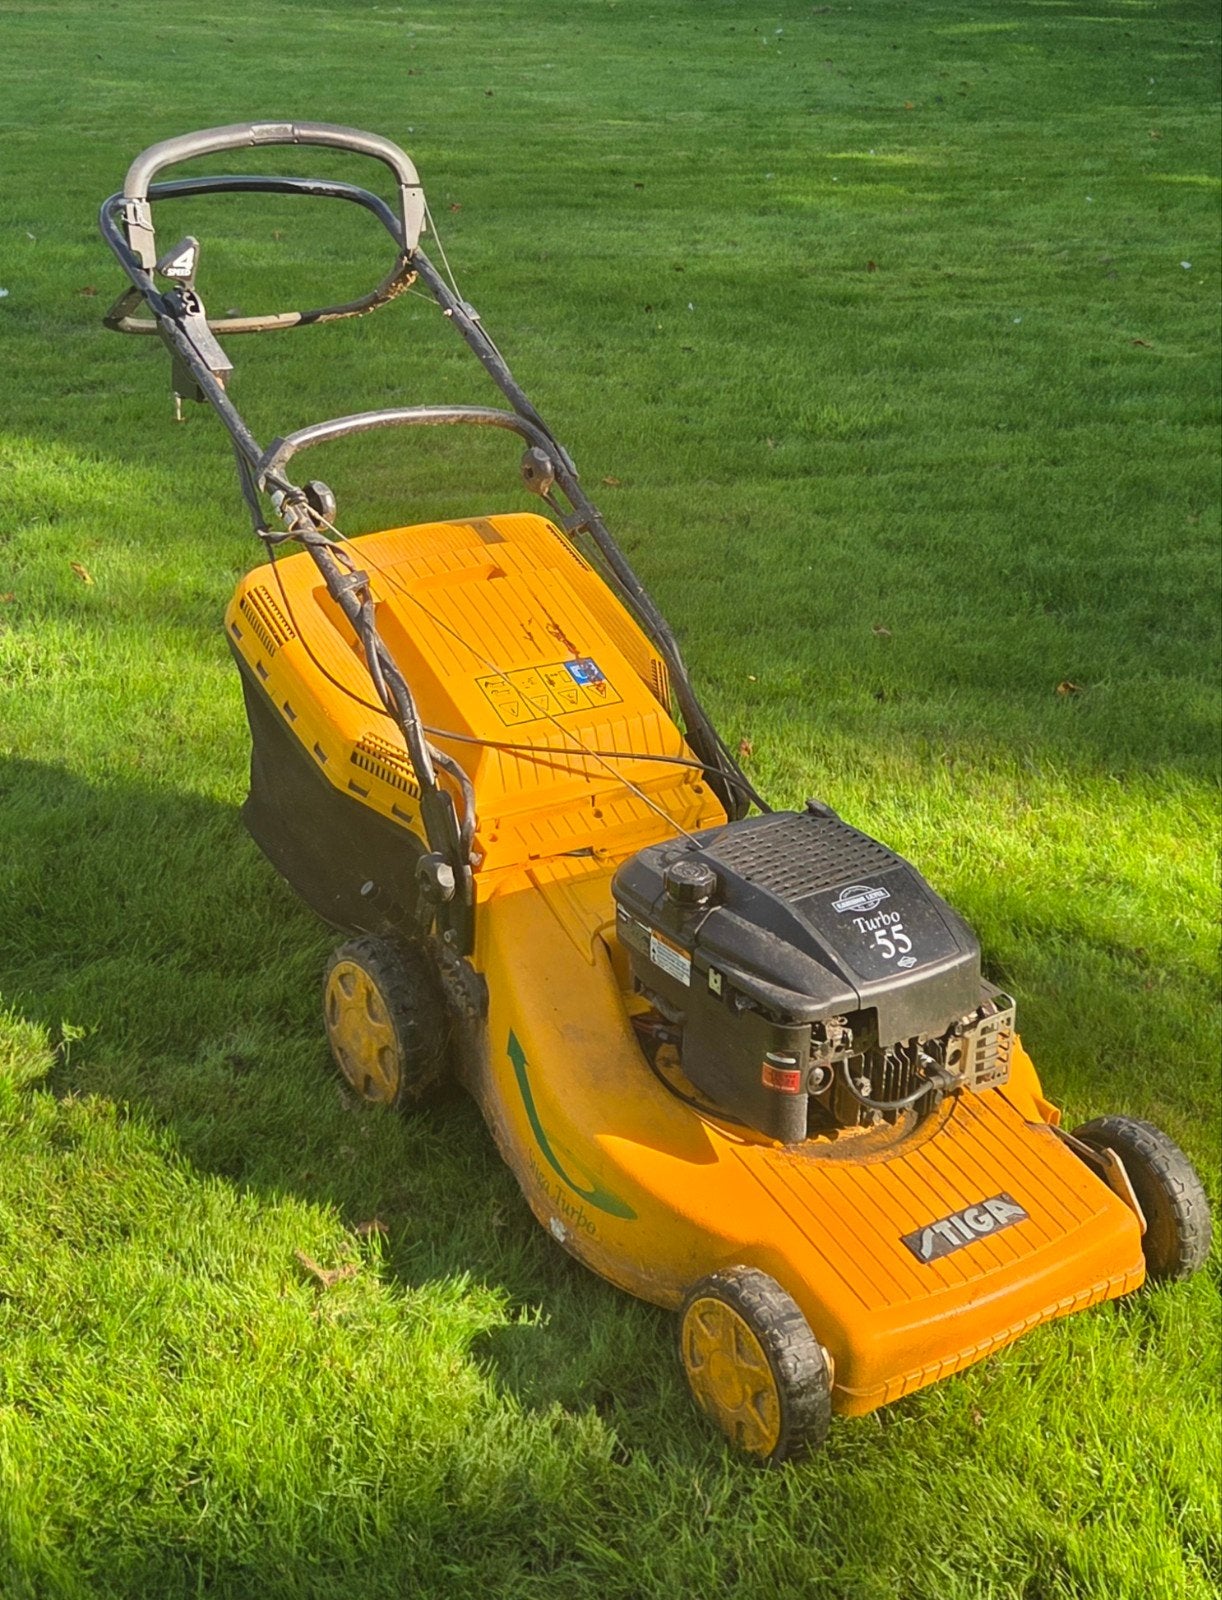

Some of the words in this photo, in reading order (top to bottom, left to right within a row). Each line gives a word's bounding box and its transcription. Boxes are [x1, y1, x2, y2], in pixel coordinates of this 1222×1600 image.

[167, 267, 192, 277] SPEED
[172, 247, 195, 270] 4
[852, 910, 901, 934] Turbo
[874, 923, 913, 959] 55
[554, 1184, 597, 1235] Turbo
[920, 1199, 1027, 1259] STIGA
